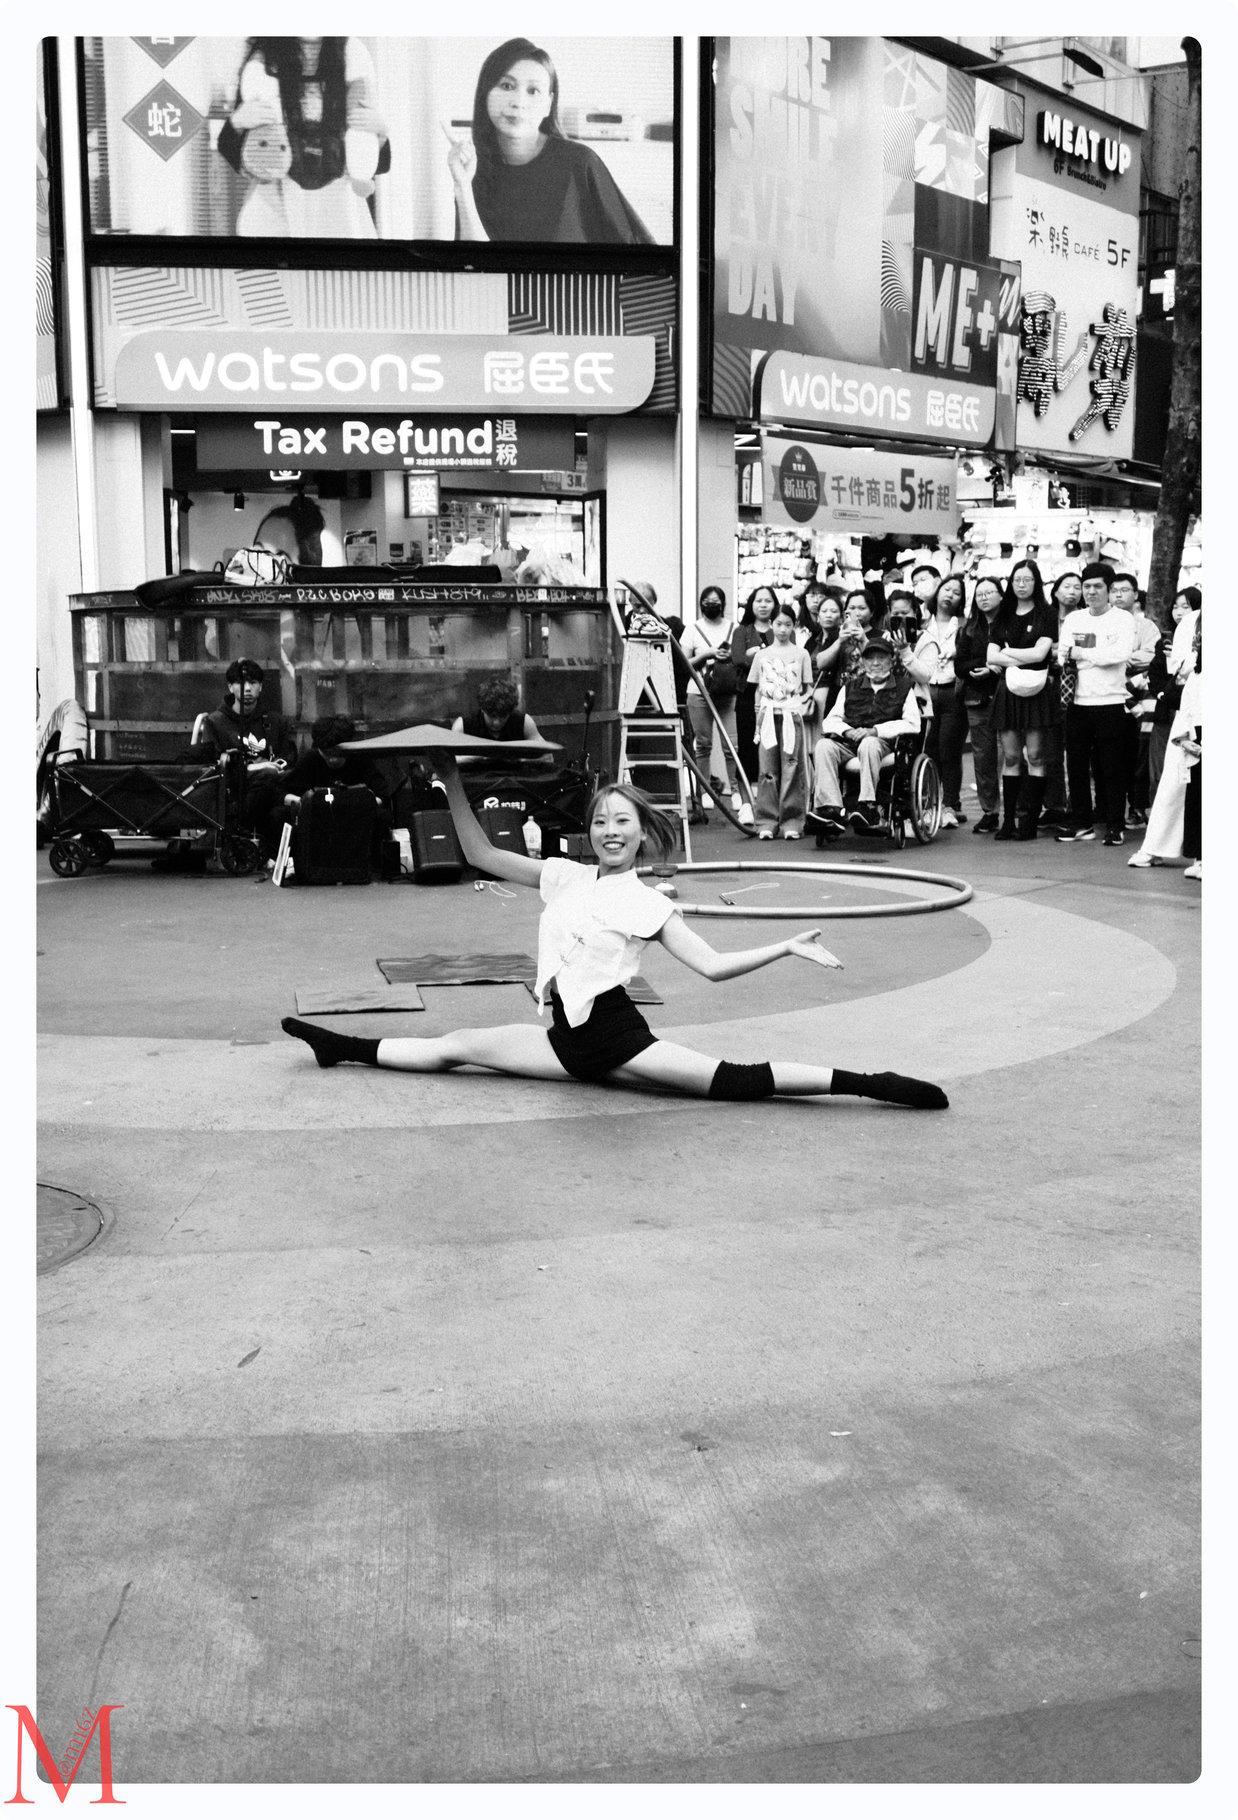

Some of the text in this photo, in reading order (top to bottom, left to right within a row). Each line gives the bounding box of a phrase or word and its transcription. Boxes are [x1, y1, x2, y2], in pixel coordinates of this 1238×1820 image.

[147, 102, 183, 137] 蛇
[1043, 110, 1132, 175] MEAT UP
[1107, 238, 1132, 269] 5F
[727, 255, 800, 327] DAY
[154, 347, 445, 392] watsons
[483, 350, 614, 394] 屈臣氏
[780, 368, 912, 423] watsons
[926, 389, 980, 432] 屈臣氏
[254, 420, 493, 455] Tax Refund
[495, 418, 518, 467] 退稅
[831, 467, 952, 513] 千件商品5折起
